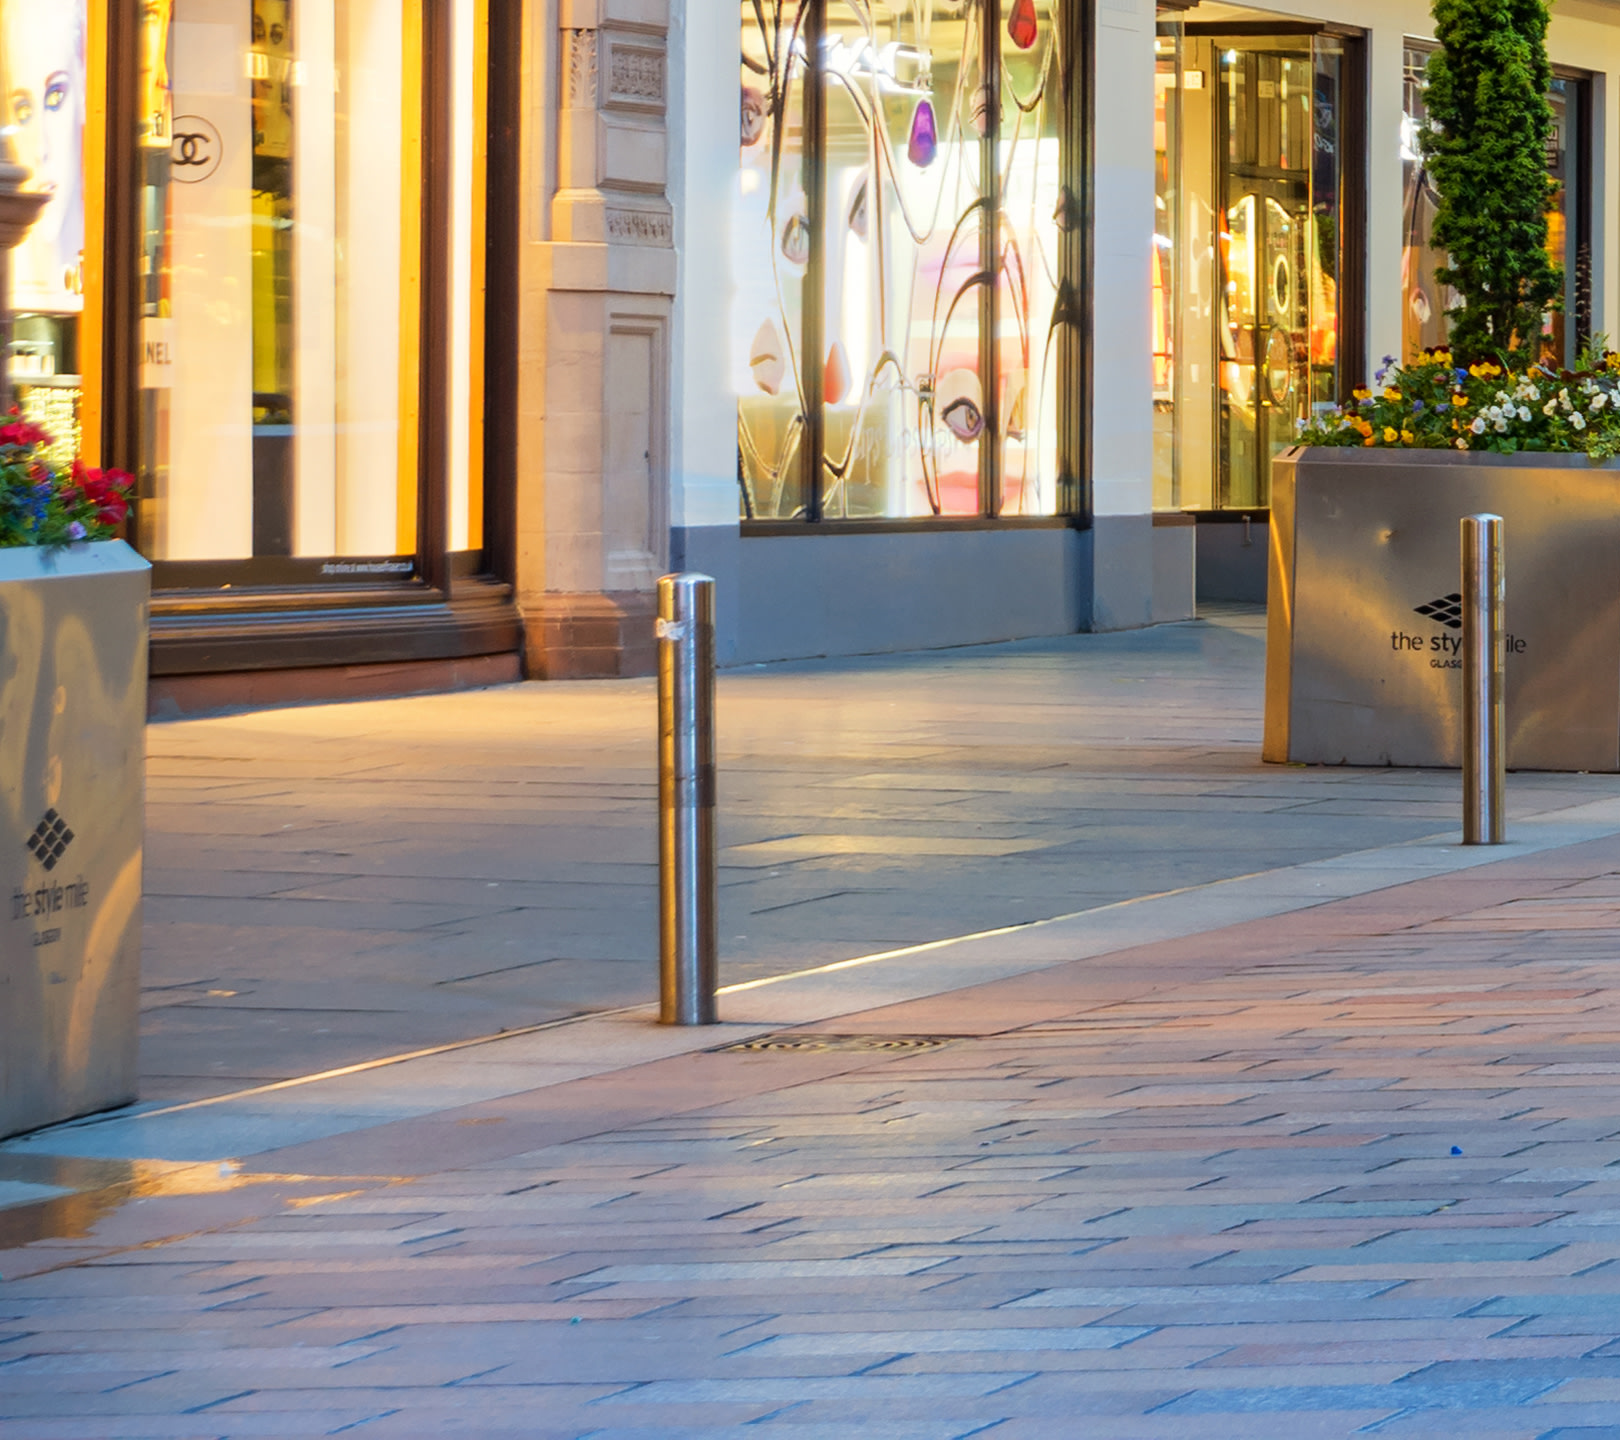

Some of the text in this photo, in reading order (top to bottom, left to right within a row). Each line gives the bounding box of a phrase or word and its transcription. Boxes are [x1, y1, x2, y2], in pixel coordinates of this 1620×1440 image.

[1390, 631, 1527, 656] the sty ile
[1430, 659, 1463, 670] GLASG
